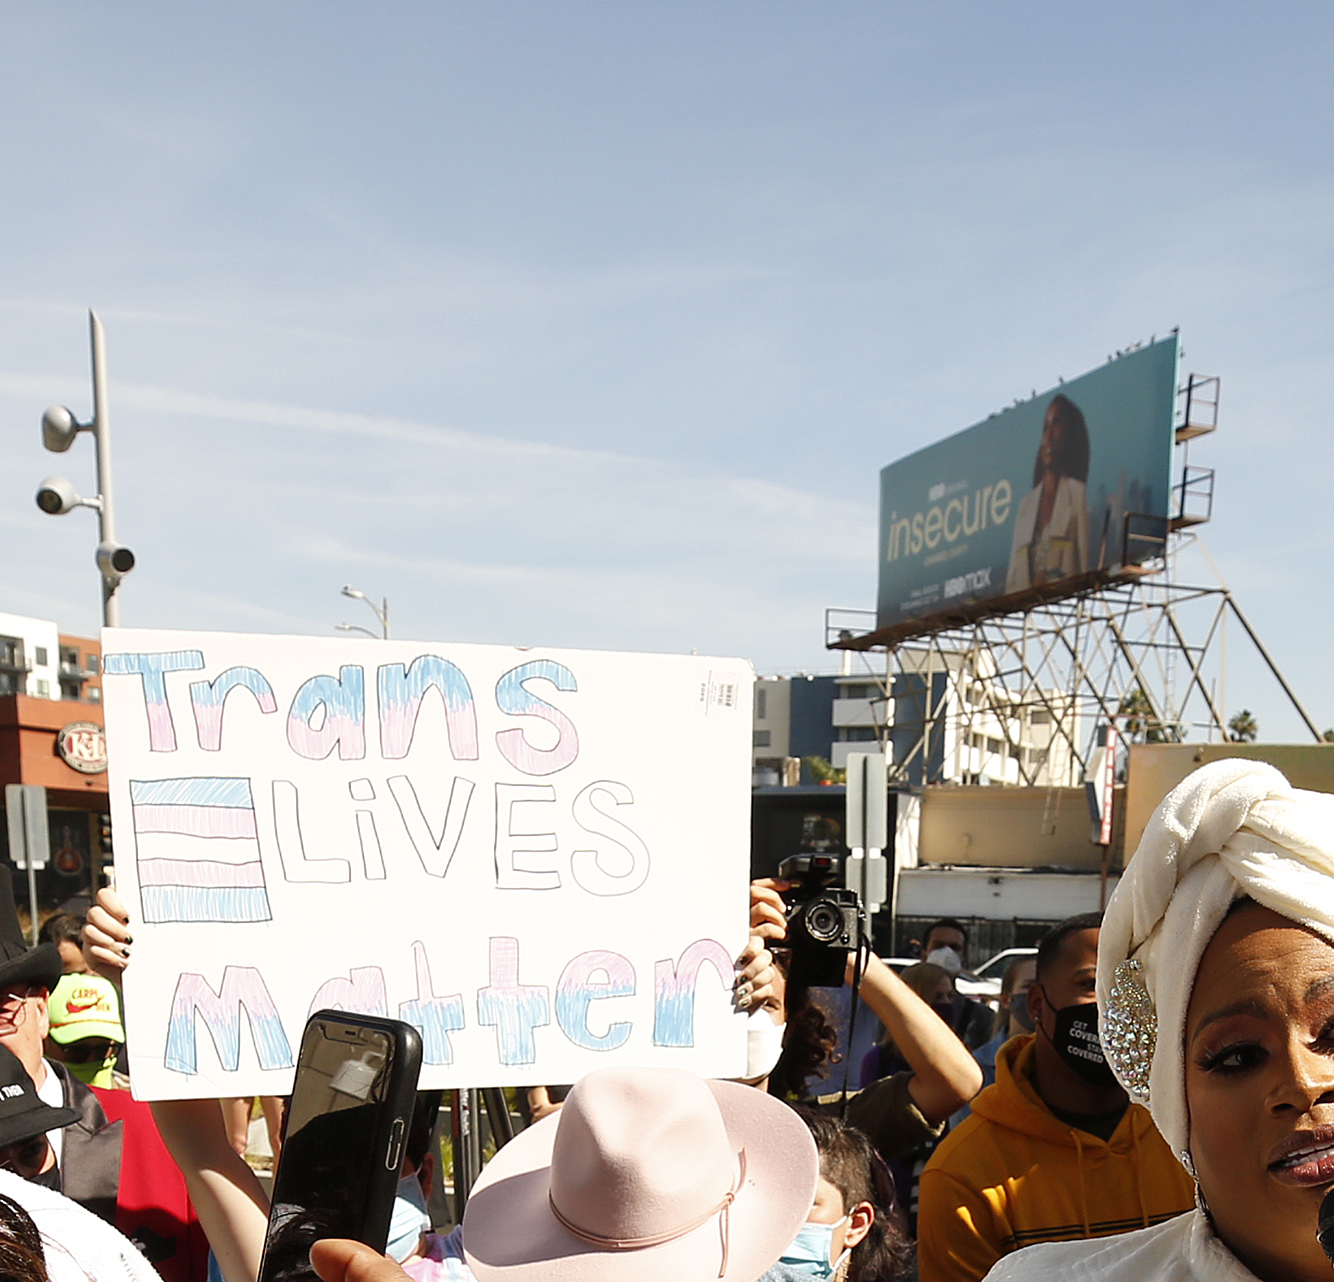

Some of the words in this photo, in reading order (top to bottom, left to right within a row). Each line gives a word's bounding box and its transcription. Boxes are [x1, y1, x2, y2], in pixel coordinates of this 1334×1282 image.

[888, 479, 1012, 561] insecure
[103, 650, 578, 776] Trans
[1073, 1020, 1088, 1030] GET
[1067, 1045, 1103, 1063] COVERED
